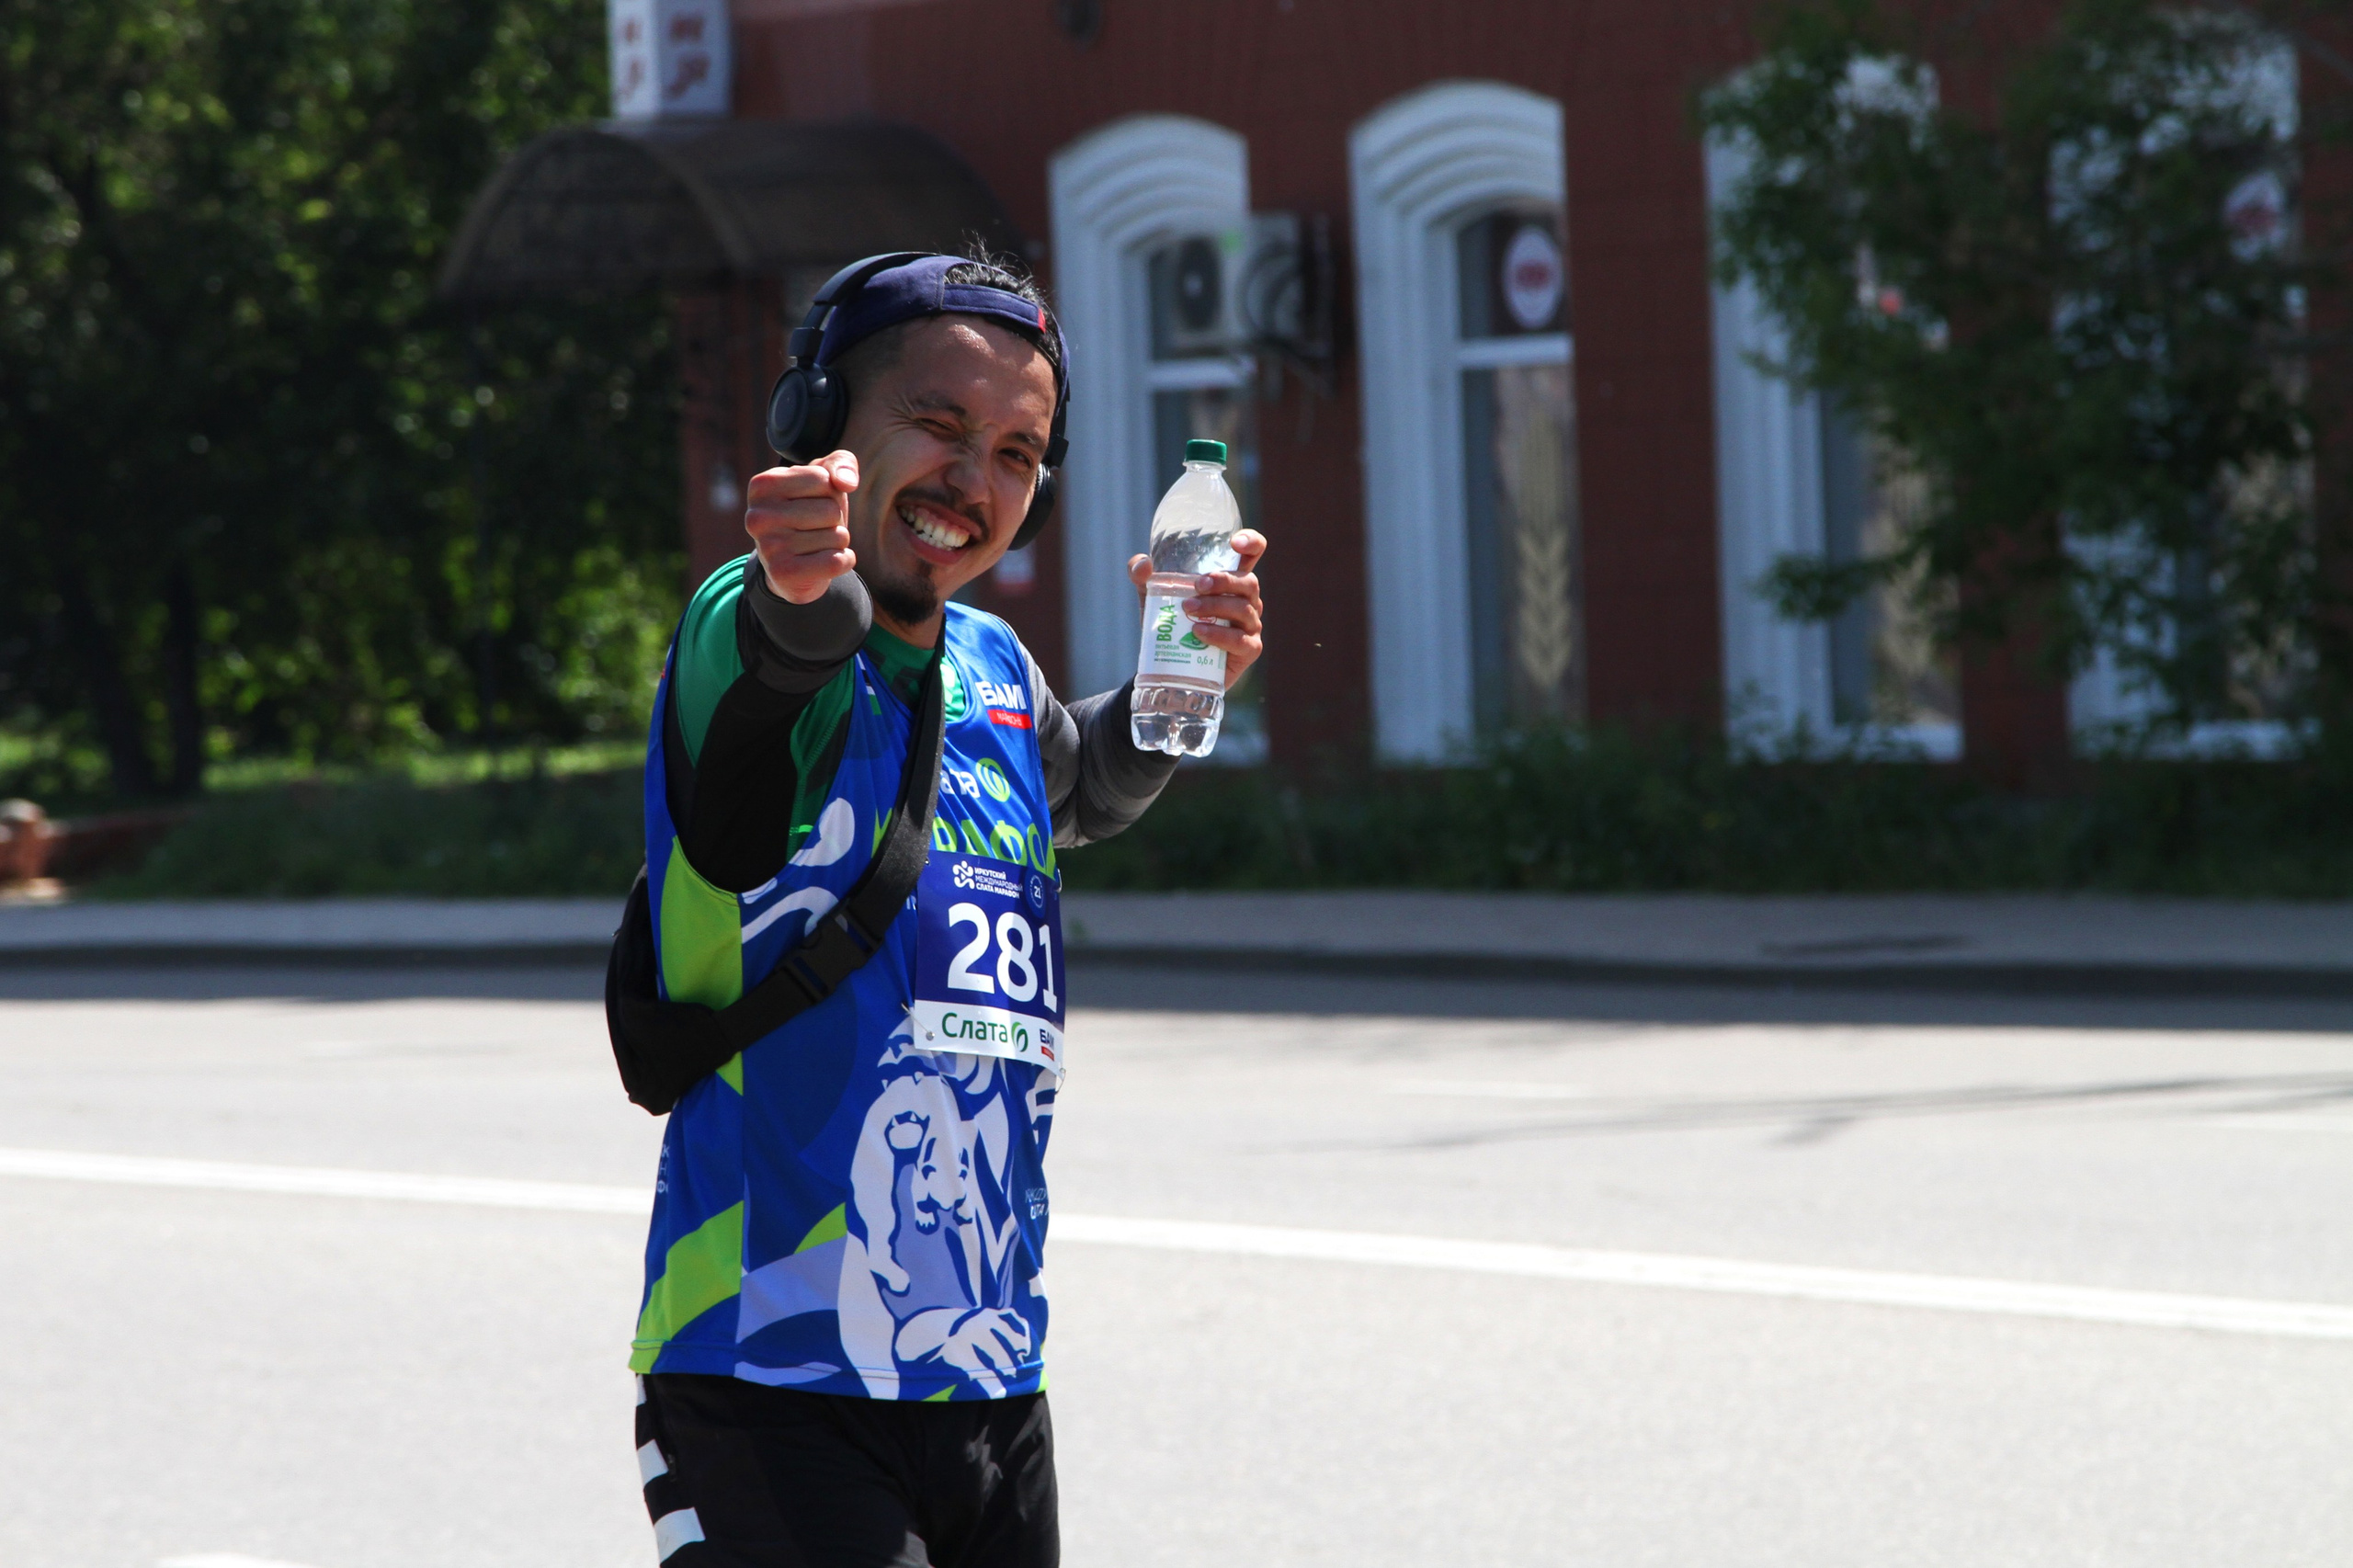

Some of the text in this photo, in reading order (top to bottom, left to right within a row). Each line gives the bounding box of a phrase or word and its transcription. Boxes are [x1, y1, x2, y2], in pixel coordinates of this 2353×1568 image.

[1156, 604, 1177, 642] ВОДА
[1197, 655, 1209, 665] 0,6
[940, 768, 981, 799] ата
[974, 867, 1006, 881] ИРКУТСКИЙ
[976, 883, 994, 893] СЛАТА
[948, 903, 1057, 1013] 281
[942, 1012, 1008, 1043] Слата
